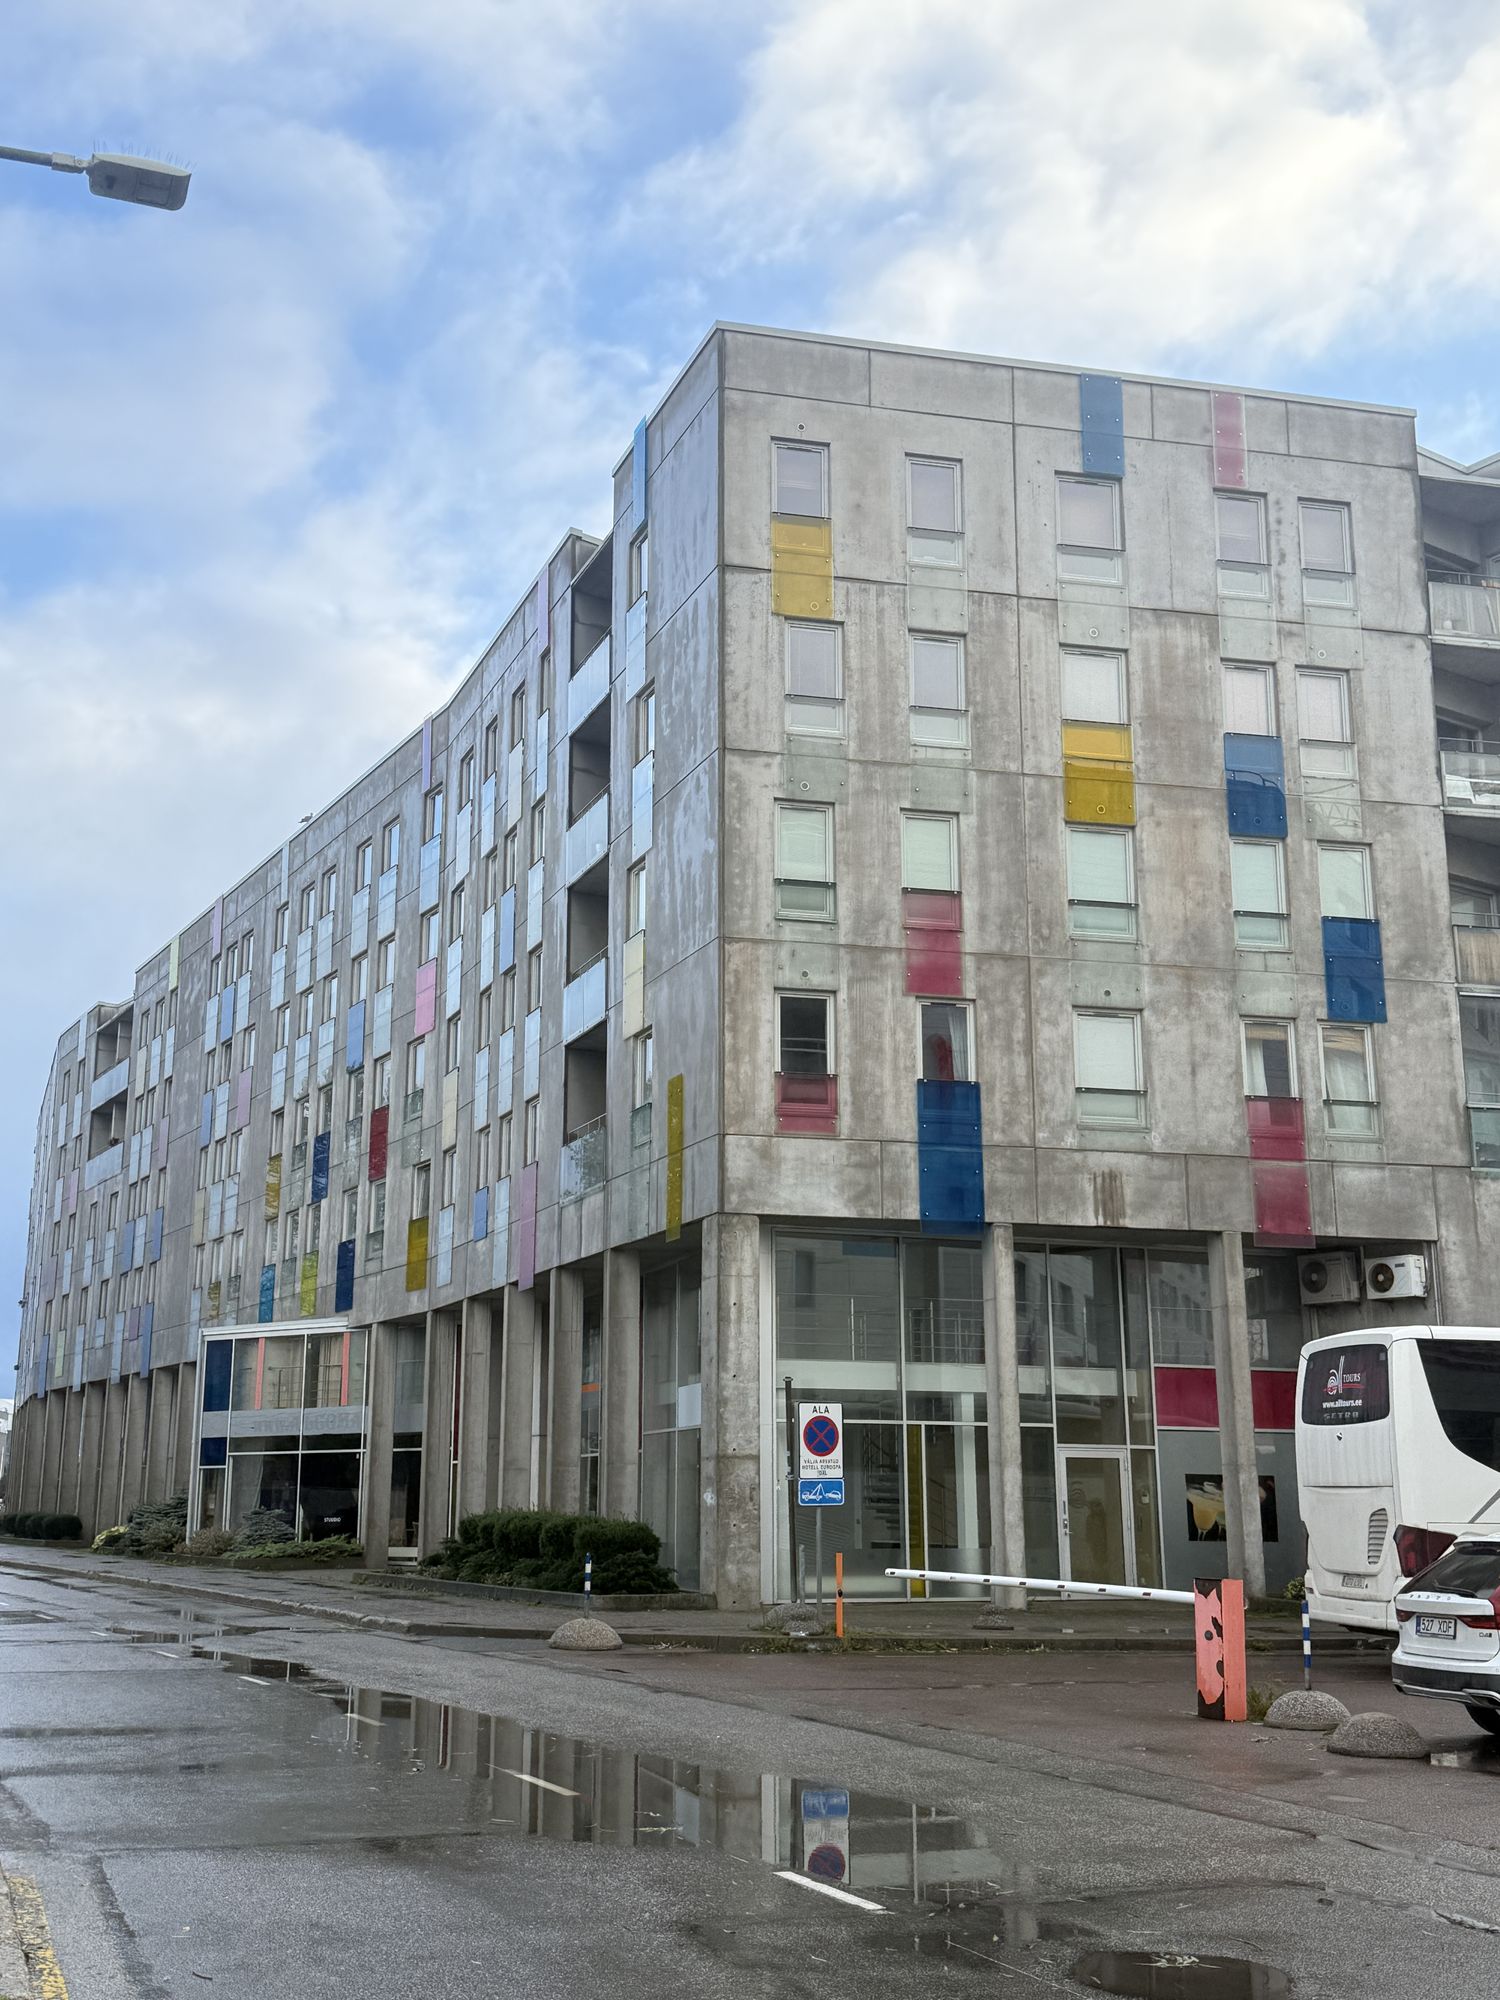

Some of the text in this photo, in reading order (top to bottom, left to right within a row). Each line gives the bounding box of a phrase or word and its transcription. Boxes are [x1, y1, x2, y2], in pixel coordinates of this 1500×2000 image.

[1343, 1373, 1361, 1383] TOURS
[812, 1405, 830, 1414] ALA
[1422, 1618, 1452, 1634] 527 XDF
